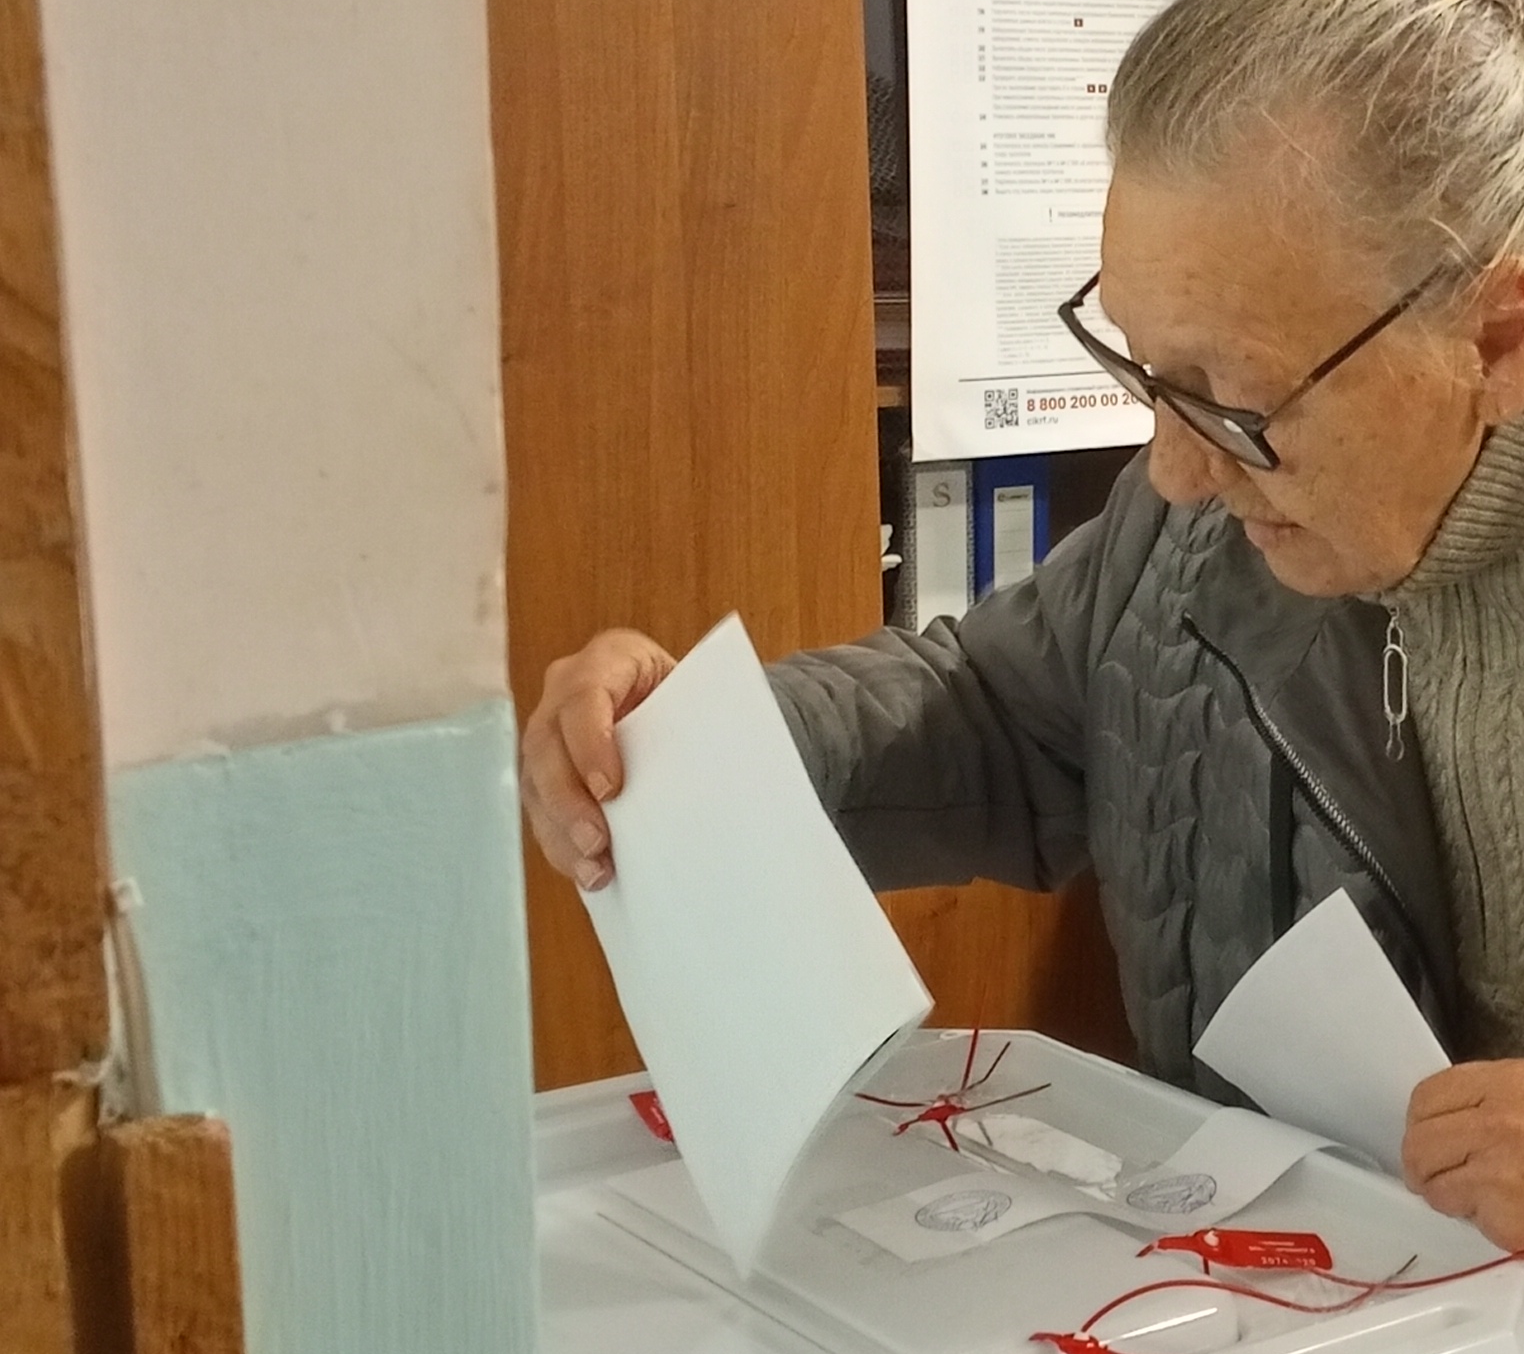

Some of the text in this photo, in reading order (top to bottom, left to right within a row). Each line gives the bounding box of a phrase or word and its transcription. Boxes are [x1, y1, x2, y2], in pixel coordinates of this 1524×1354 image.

[1027, 398, 1035, 412] 8
[1040, 396, 1066, 411] 800
[1070, 394, 1097, 409] 200
[1101, 392, 1118, 407] 00
